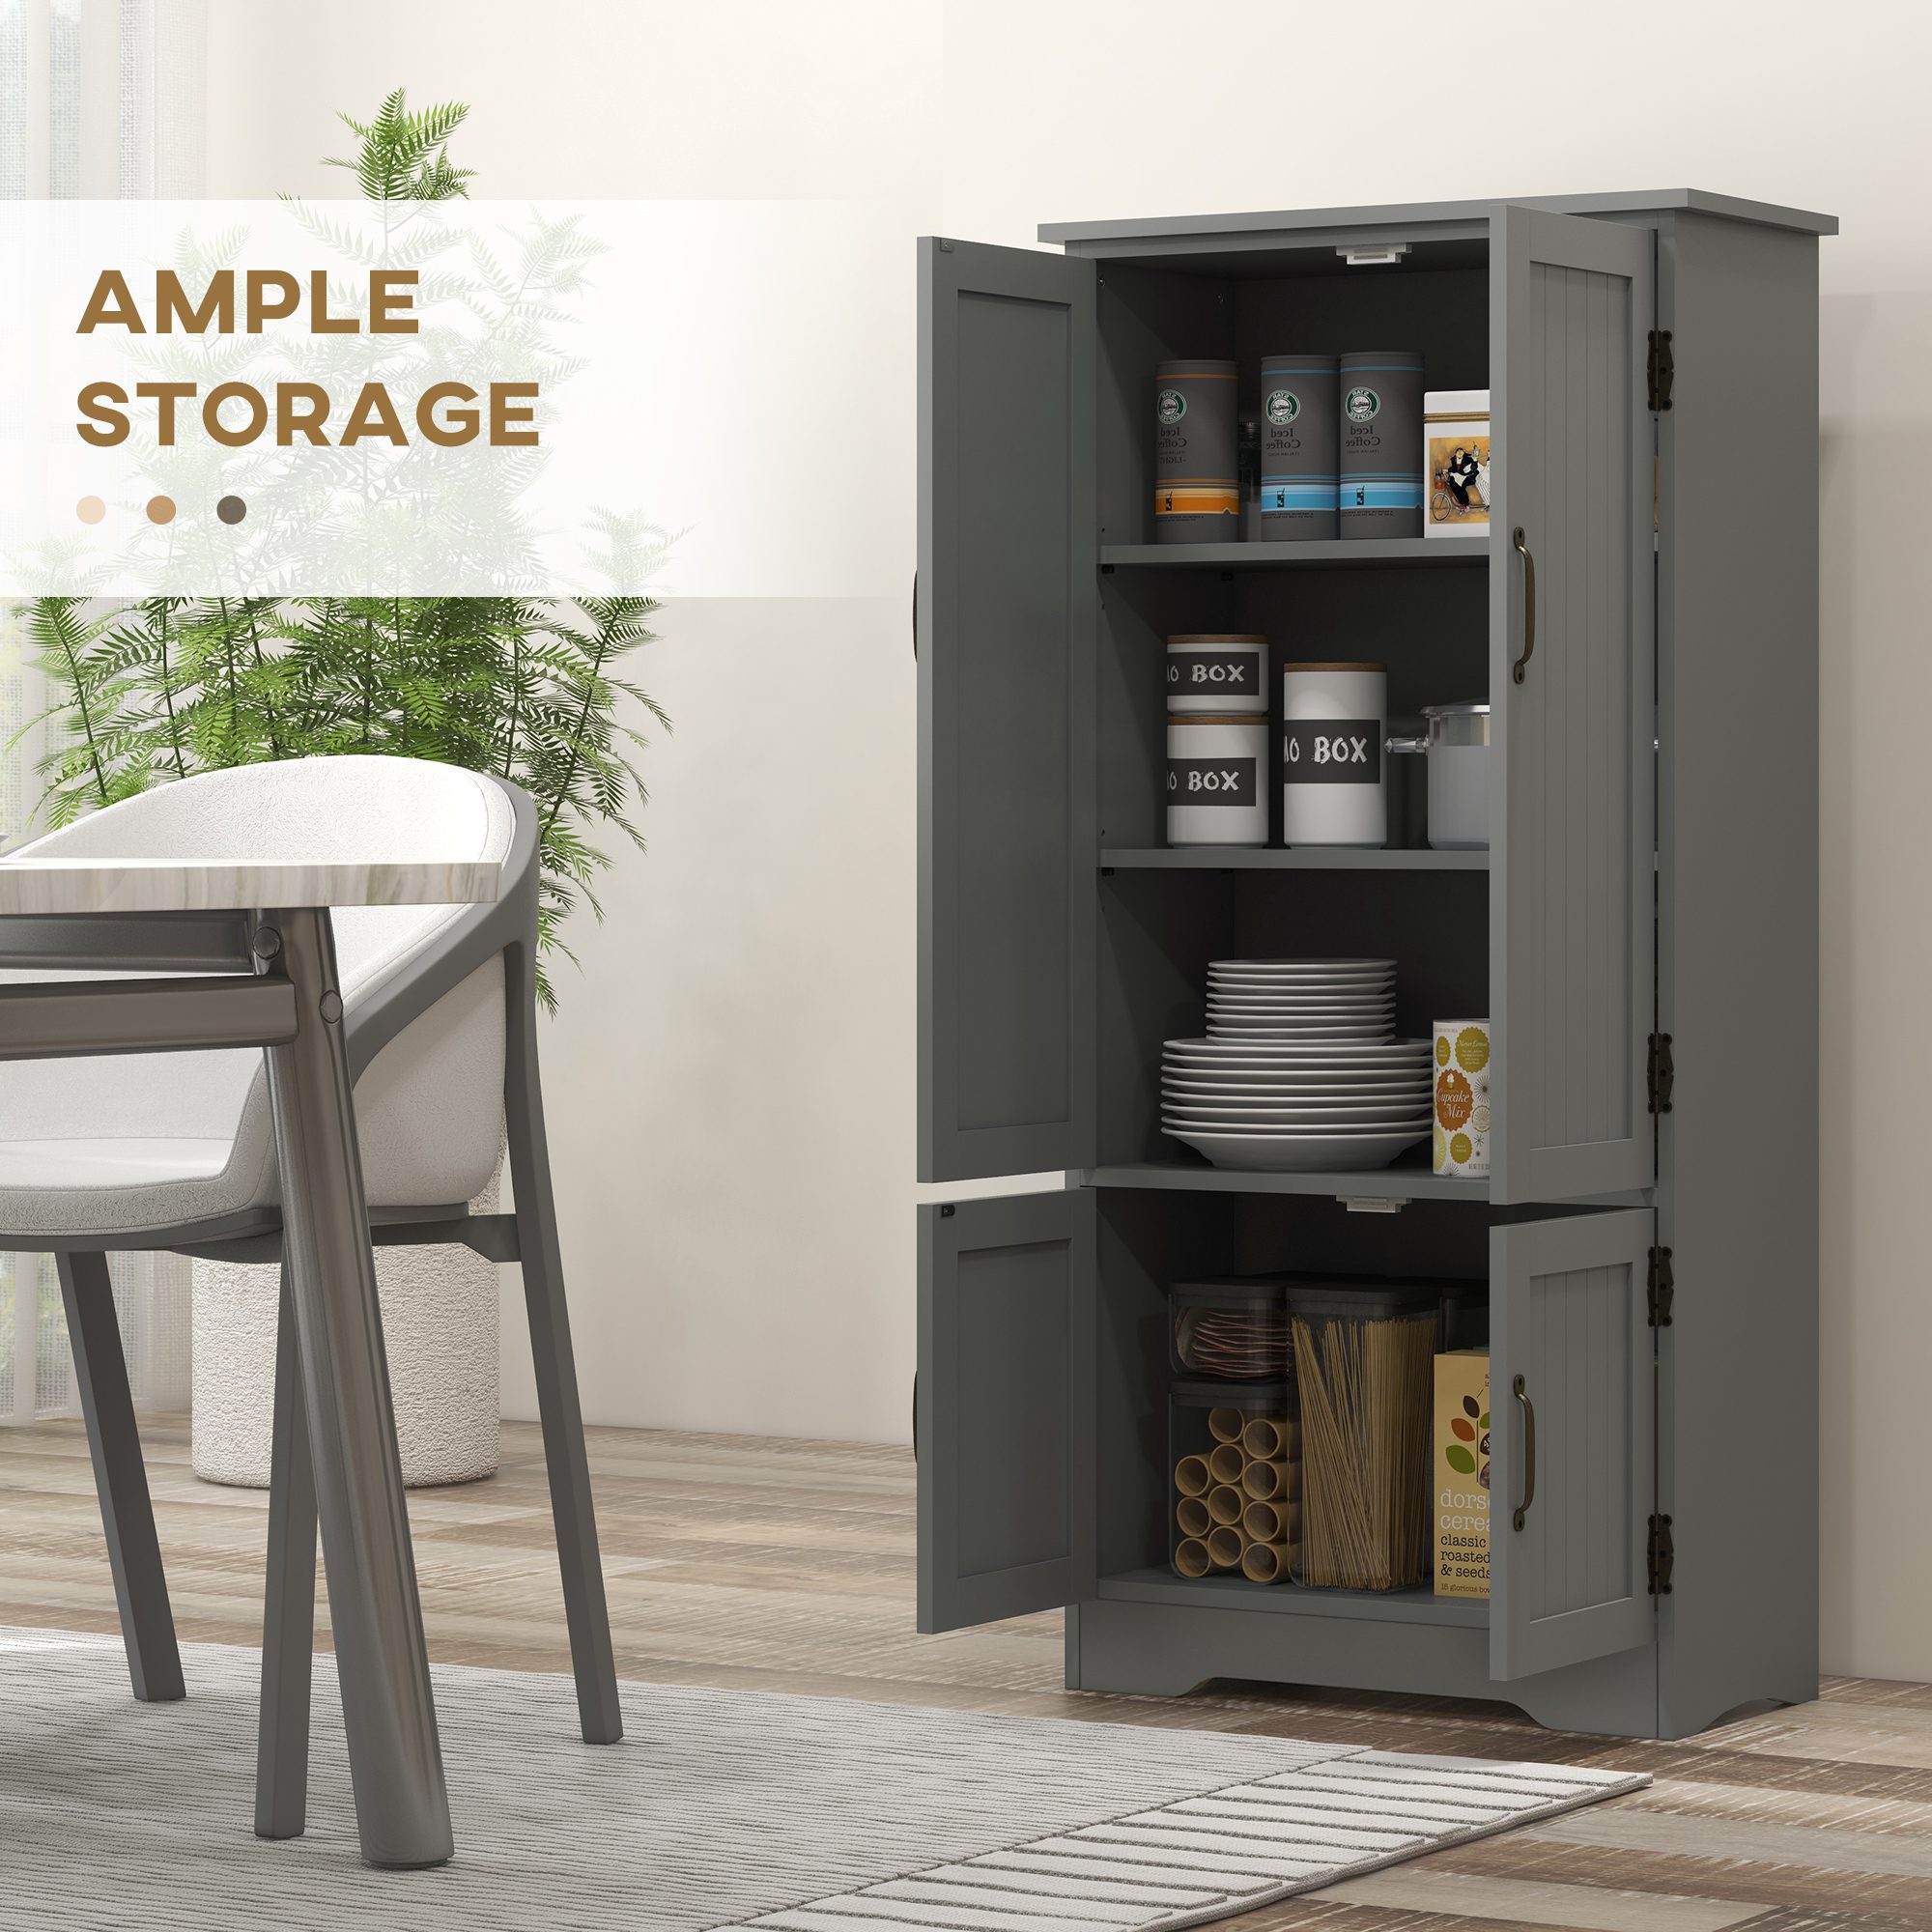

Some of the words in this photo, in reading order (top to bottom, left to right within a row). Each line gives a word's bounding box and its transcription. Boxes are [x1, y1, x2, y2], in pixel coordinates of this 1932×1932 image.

[1191, 665, 1245, 683] BOX
[1313, 736, 1368, 764] BOX
[1188, 771, 1239, 792] BOX
[1440, 1489, 1490, 1509] dors
[1440, 1534, 1487, 1548] classic
[1440, 1550, 1490, 1564] roasted
[1440, 1563, 1452, 1577] &
